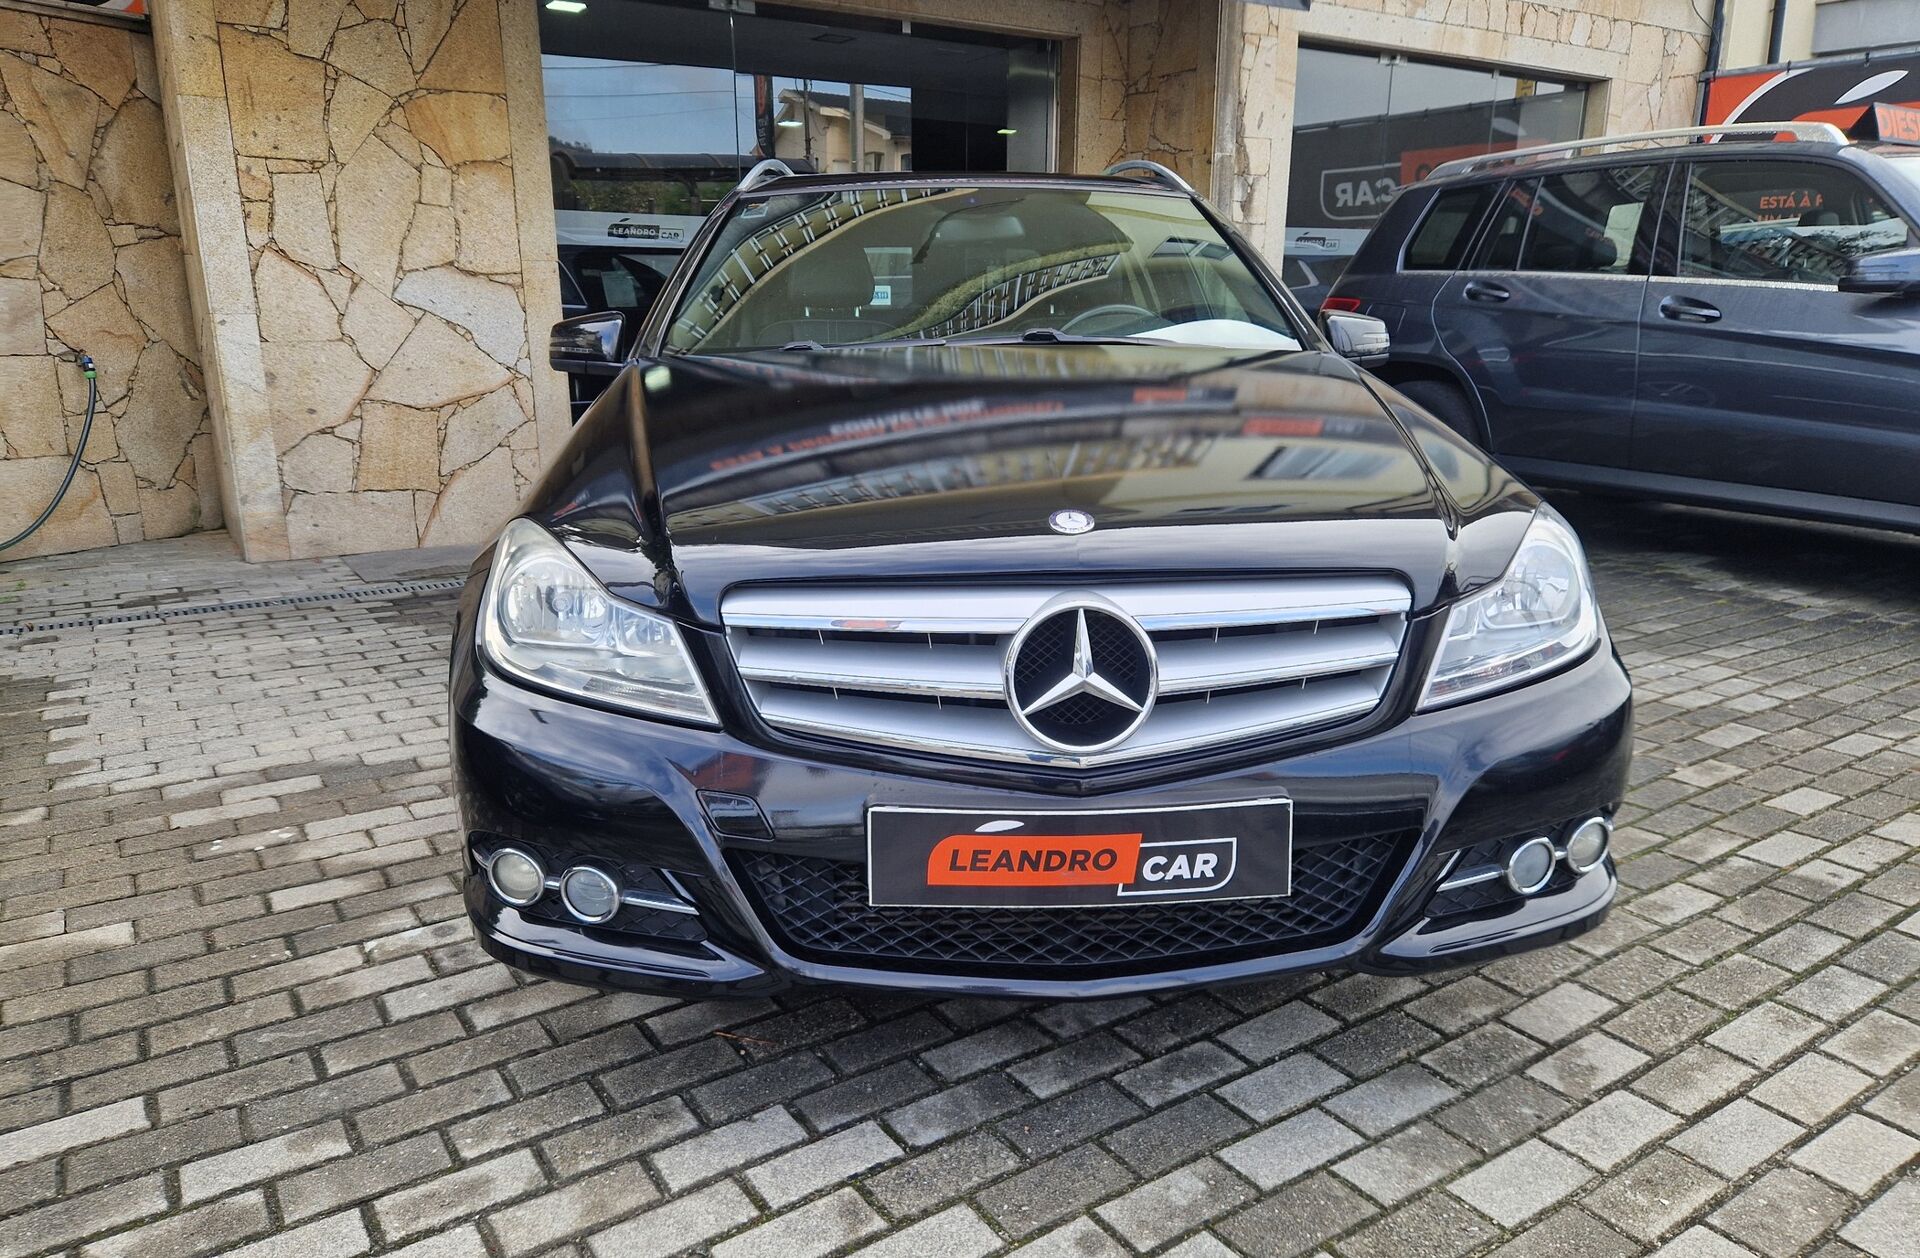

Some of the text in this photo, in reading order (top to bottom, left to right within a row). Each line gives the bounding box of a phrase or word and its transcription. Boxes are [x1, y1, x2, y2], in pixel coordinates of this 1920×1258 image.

[1876, 106, 1920, 141] DIES
[1759, 191, 1796, 209] ESTÁ
[613, 227, 656, 236] LEANDRO
[949, 848, 1218, 882] LEANDRO CAR
